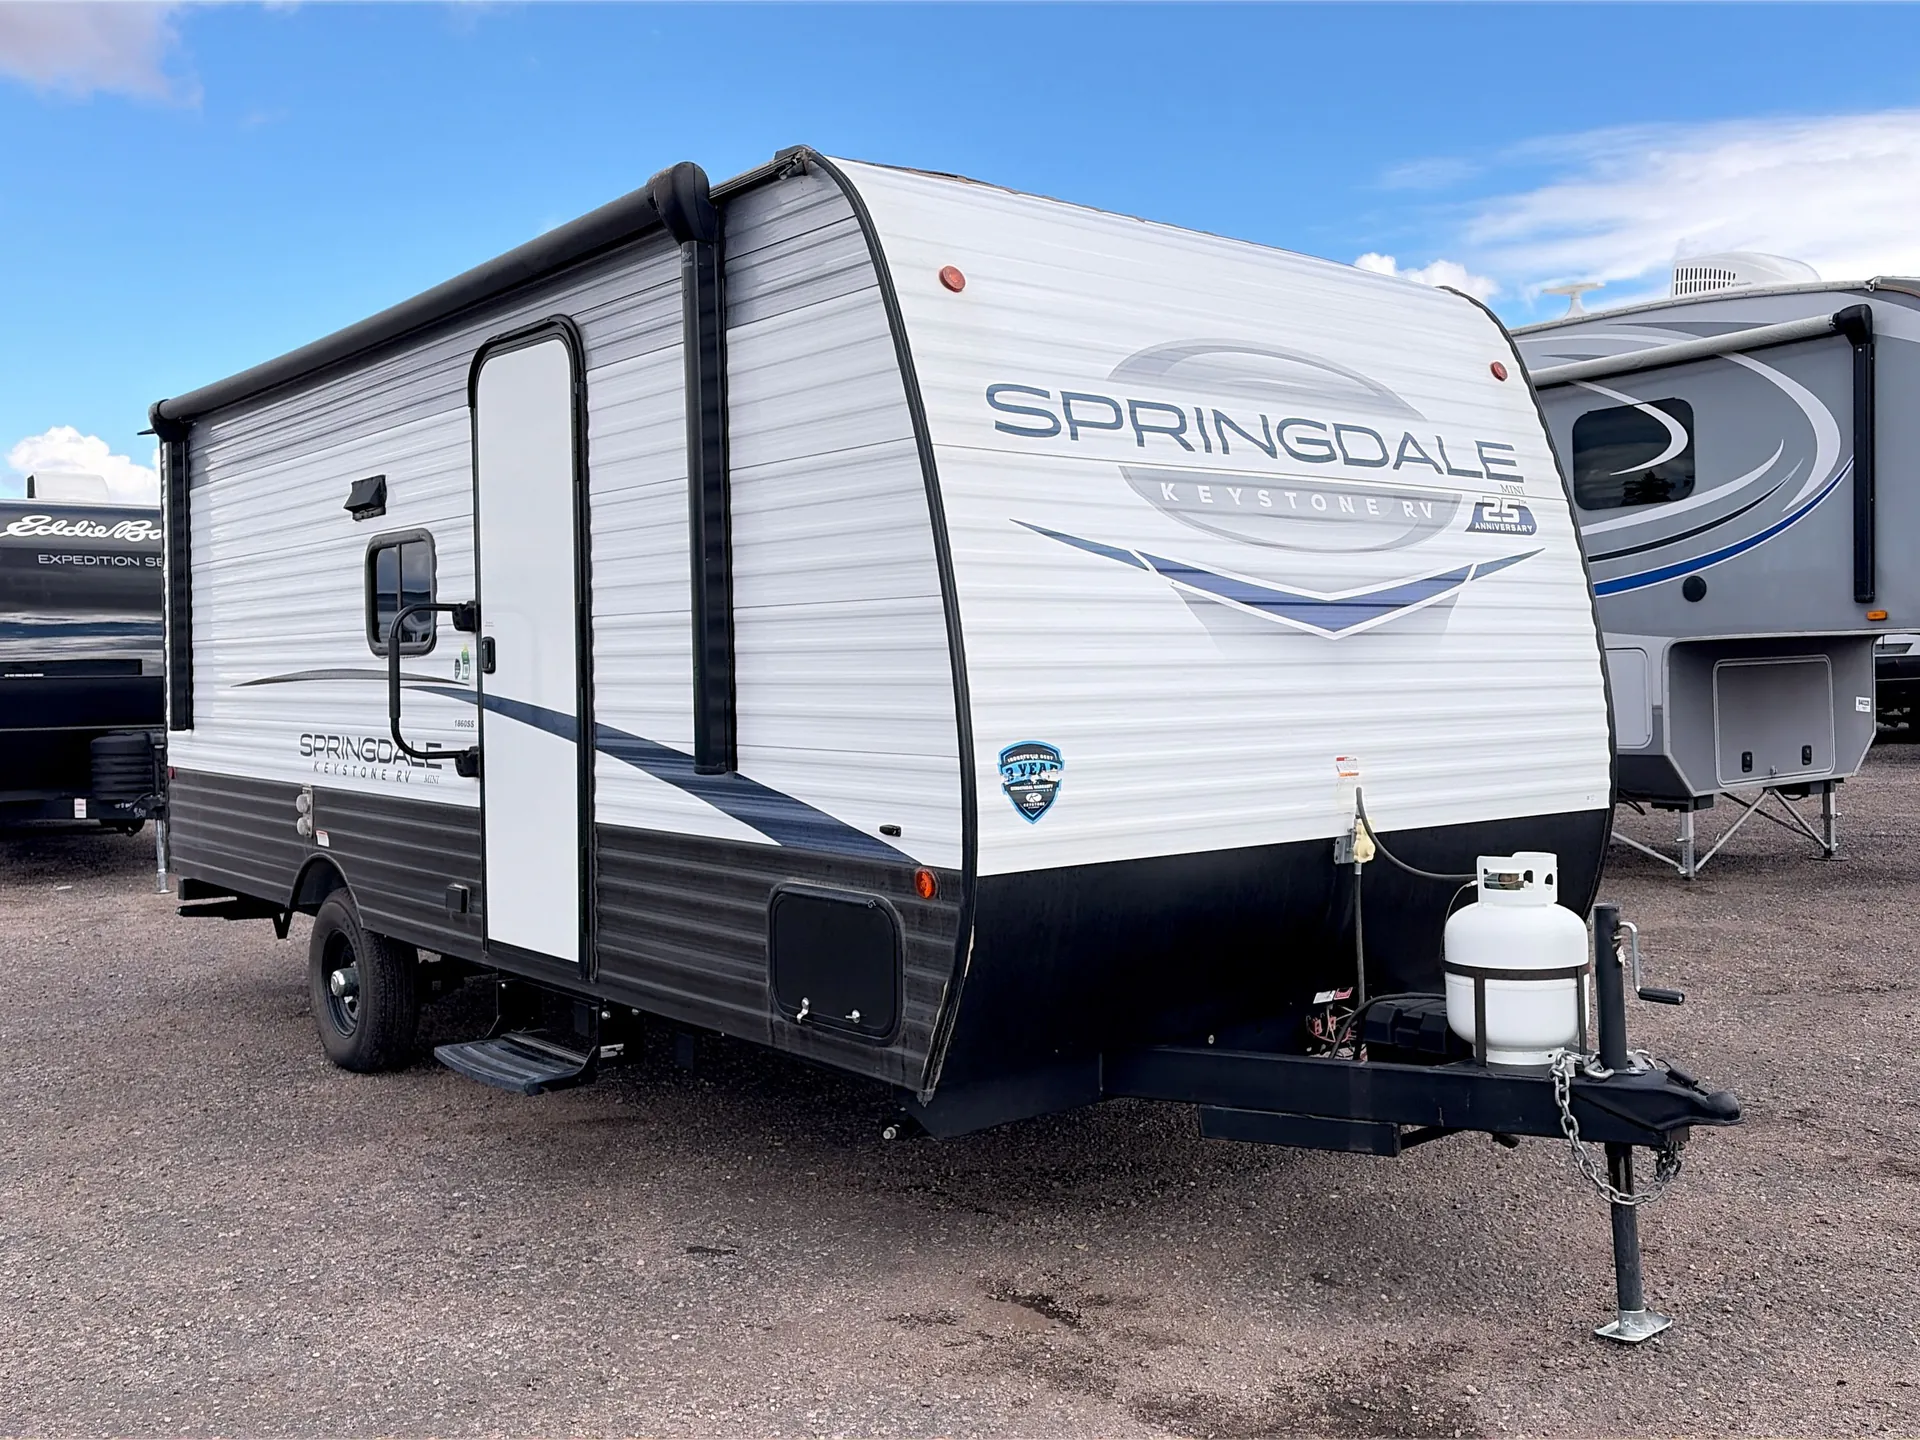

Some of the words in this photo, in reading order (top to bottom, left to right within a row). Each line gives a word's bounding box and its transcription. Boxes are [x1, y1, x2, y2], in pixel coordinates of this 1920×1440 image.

[986, 383, 1524, 483] SPRINGDALE
[1160, 482, 1380, 516] KEYSTONE
[1402, 500, 1433, 519] RV
[1500, 484, 1525, 496] MINI
[1481, 495, 1521, 524] 25
[0, 514, 110, 538] Eddie
[1475, 522, 1533, 533] ANNIVERSARY
[38, 554, 140, 567] EXPEDITION
[313, 760, 387, 781] KEYSTONE
[396, 770, 412, 784] RV
[423, 774, 440, 785] MINI
